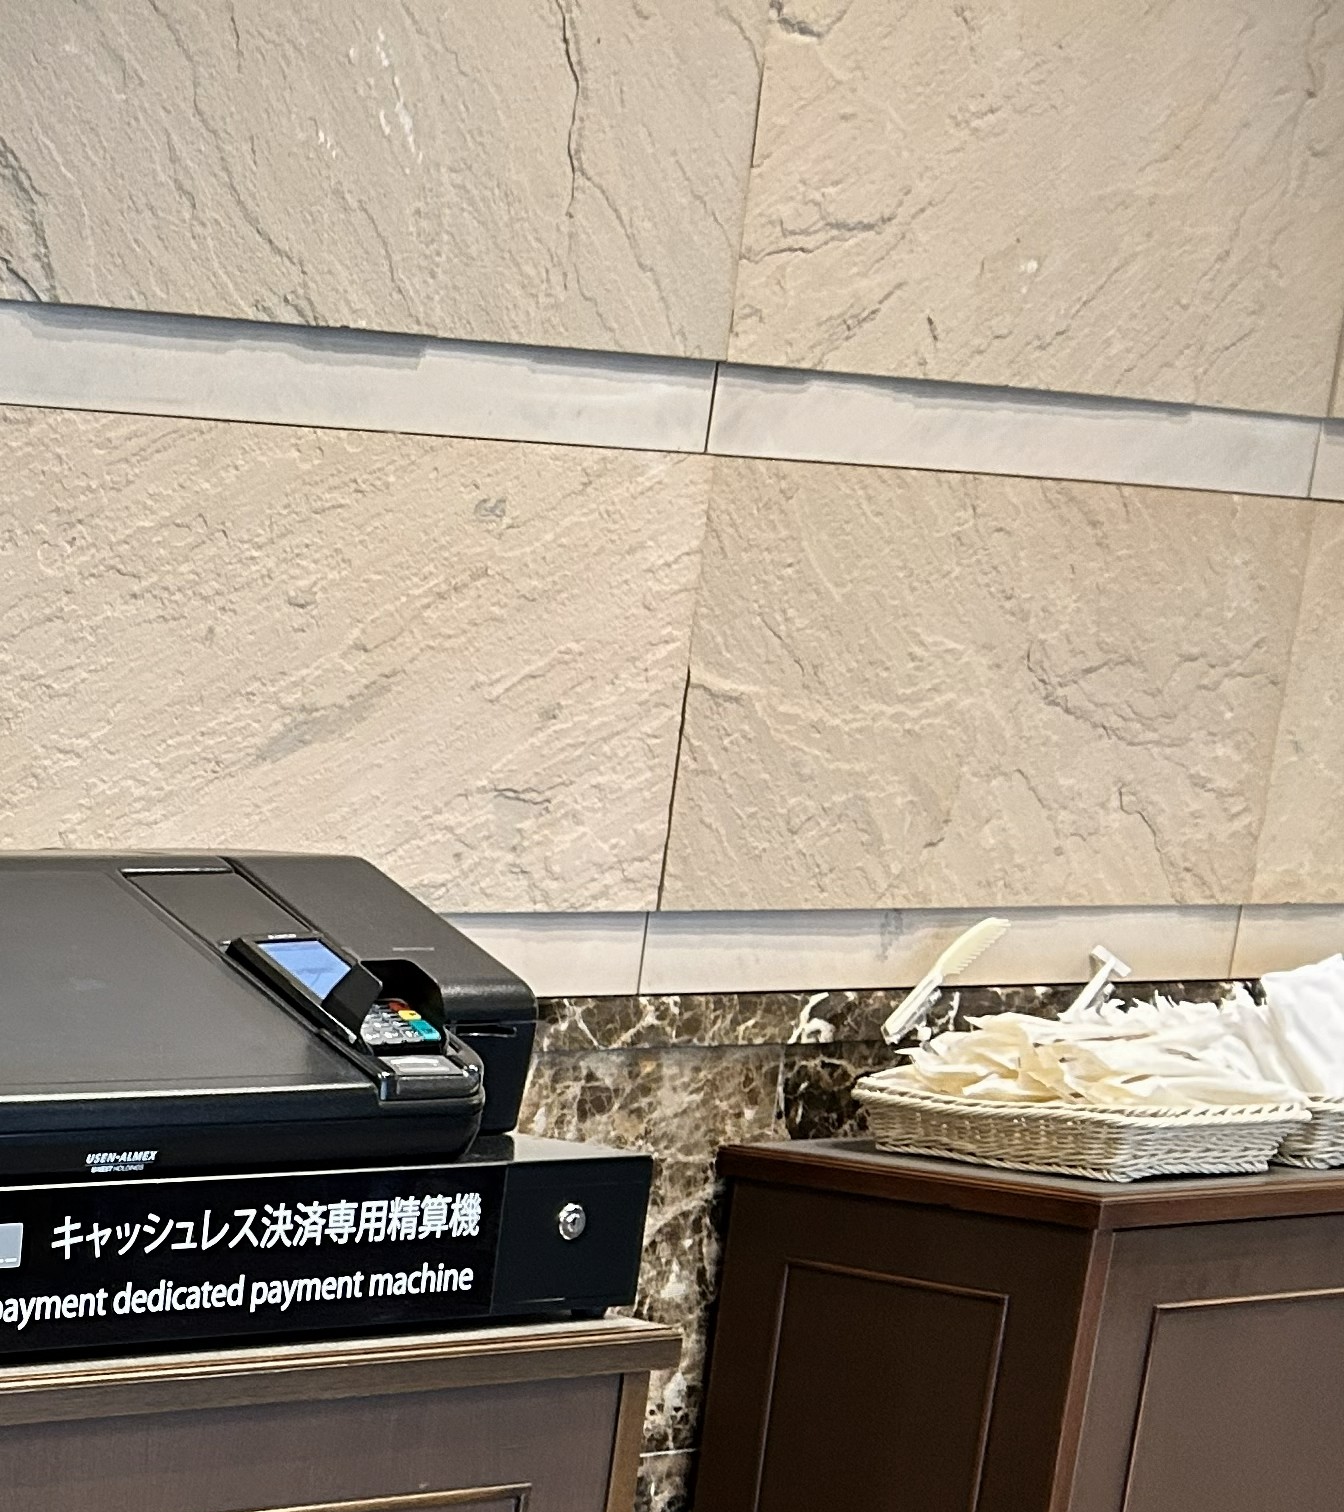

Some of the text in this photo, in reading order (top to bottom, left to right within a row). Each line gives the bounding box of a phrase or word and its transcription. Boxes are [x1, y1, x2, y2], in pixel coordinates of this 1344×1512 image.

[51, 1192, 481, 1260] キャッシュレス決済専用精算機
[113, 1274, 246, 1315] dedicated
[249, 1271, 363, 1313] payment
[369, 1262, 474, 1297] machine
